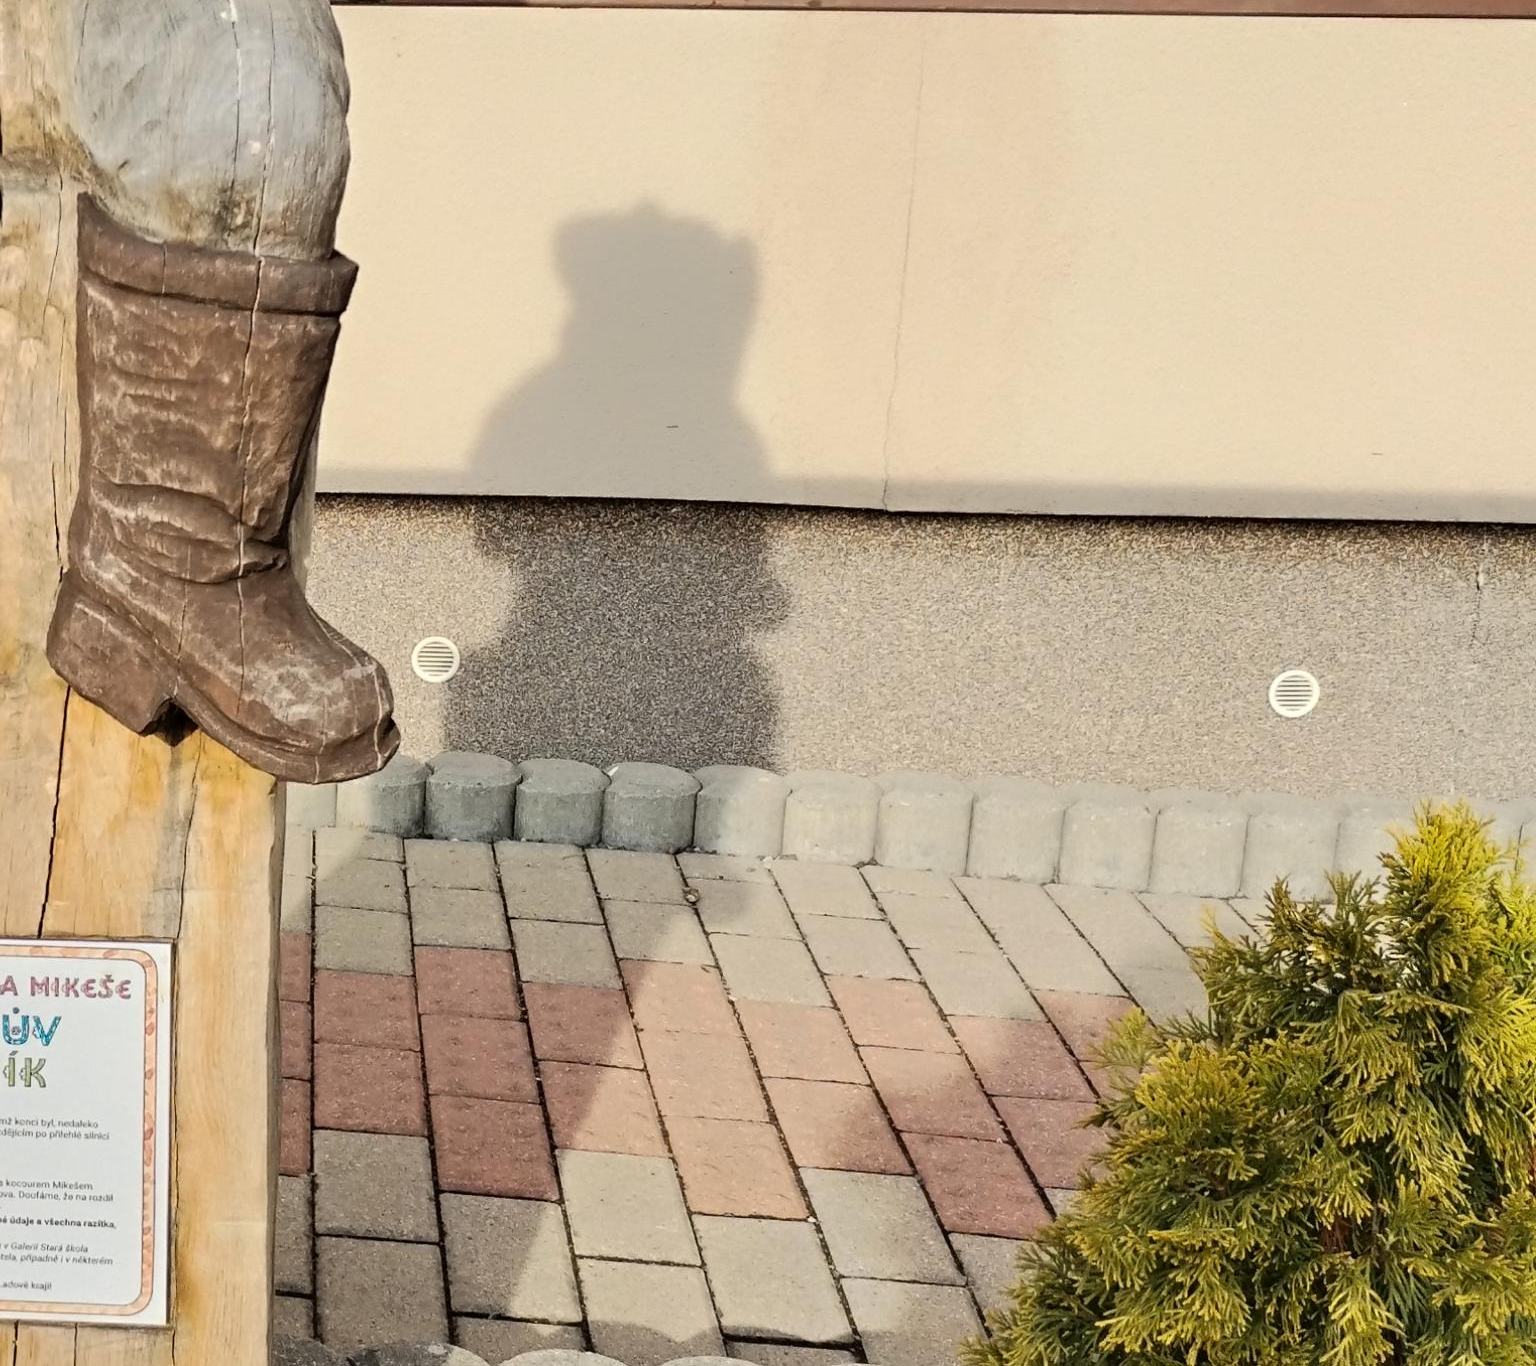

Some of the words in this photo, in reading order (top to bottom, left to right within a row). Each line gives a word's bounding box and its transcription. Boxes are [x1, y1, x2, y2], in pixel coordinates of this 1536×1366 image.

[30, 972, 132, 999] MIKEŠE
[14, 1117, 38, 1126] konci
[57, 1119, 98, 1128] nedaleko
[35, 1131, 47, 1139] po
[52, 1180, 93, 1190] Mikešem
[18, 1190, 60, 1201] Doufáme,
[62, 1192, 73, 1200] že
[9, 1216, 34, 1226] údaje
[44, 1218, 81, 1227] všechna
[40, 1243, 63, 1251] Stará
[65, 1244, 88, 1253] škola
[19, 1253, 58, 1263] případně
[72, 1255, 113, 1264] některém
